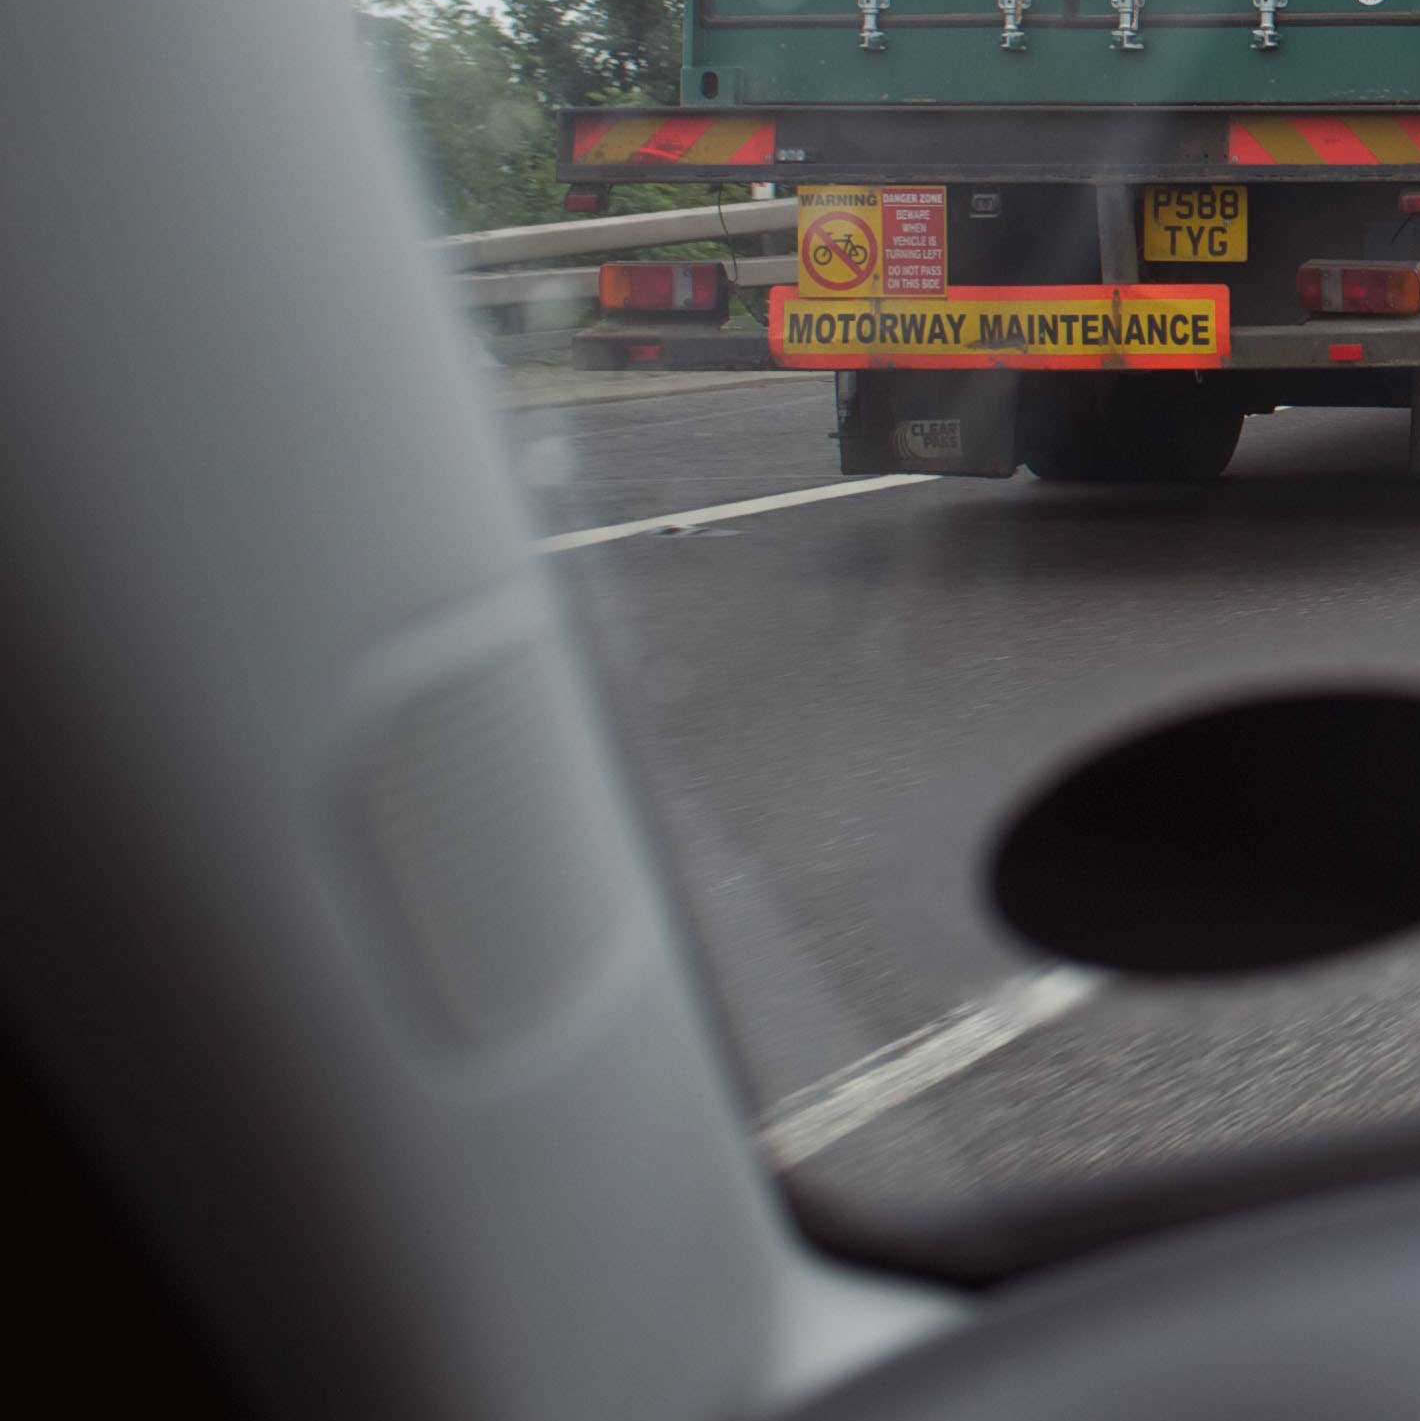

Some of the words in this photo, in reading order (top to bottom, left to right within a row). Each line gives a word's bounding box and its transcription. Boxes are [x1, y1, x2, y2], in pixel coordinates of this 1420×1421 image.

[801, 194, 877, 206] WARNING
[883, 193, 917, 204] DANGER
[920, 193, 943, 203] ZONE
[896, 210, 930, 220] BEWARE
[901, 223, 927, 232] WHEN
[893, 236, 926, 246] VEHICLE
[928, 236, 937, 246] IS
[1164, 225, 1228, 257] TYG
[885, 249, 921, 259] TURNING
[923, 249, 942, 259] LEFT
[888, 266, 900, 276] DO
[902, 265, 918, 276] NOT
[921, 265, 942, 276] PASS
[888, 279, 900, 288] ON
[902, 279, 920, 288] THIS
[922, 279, 940, 288] SIDE
[787, 313, 966, 345] MOTORWAY
[979, 314, 1210, 347] MAINTENANCE
